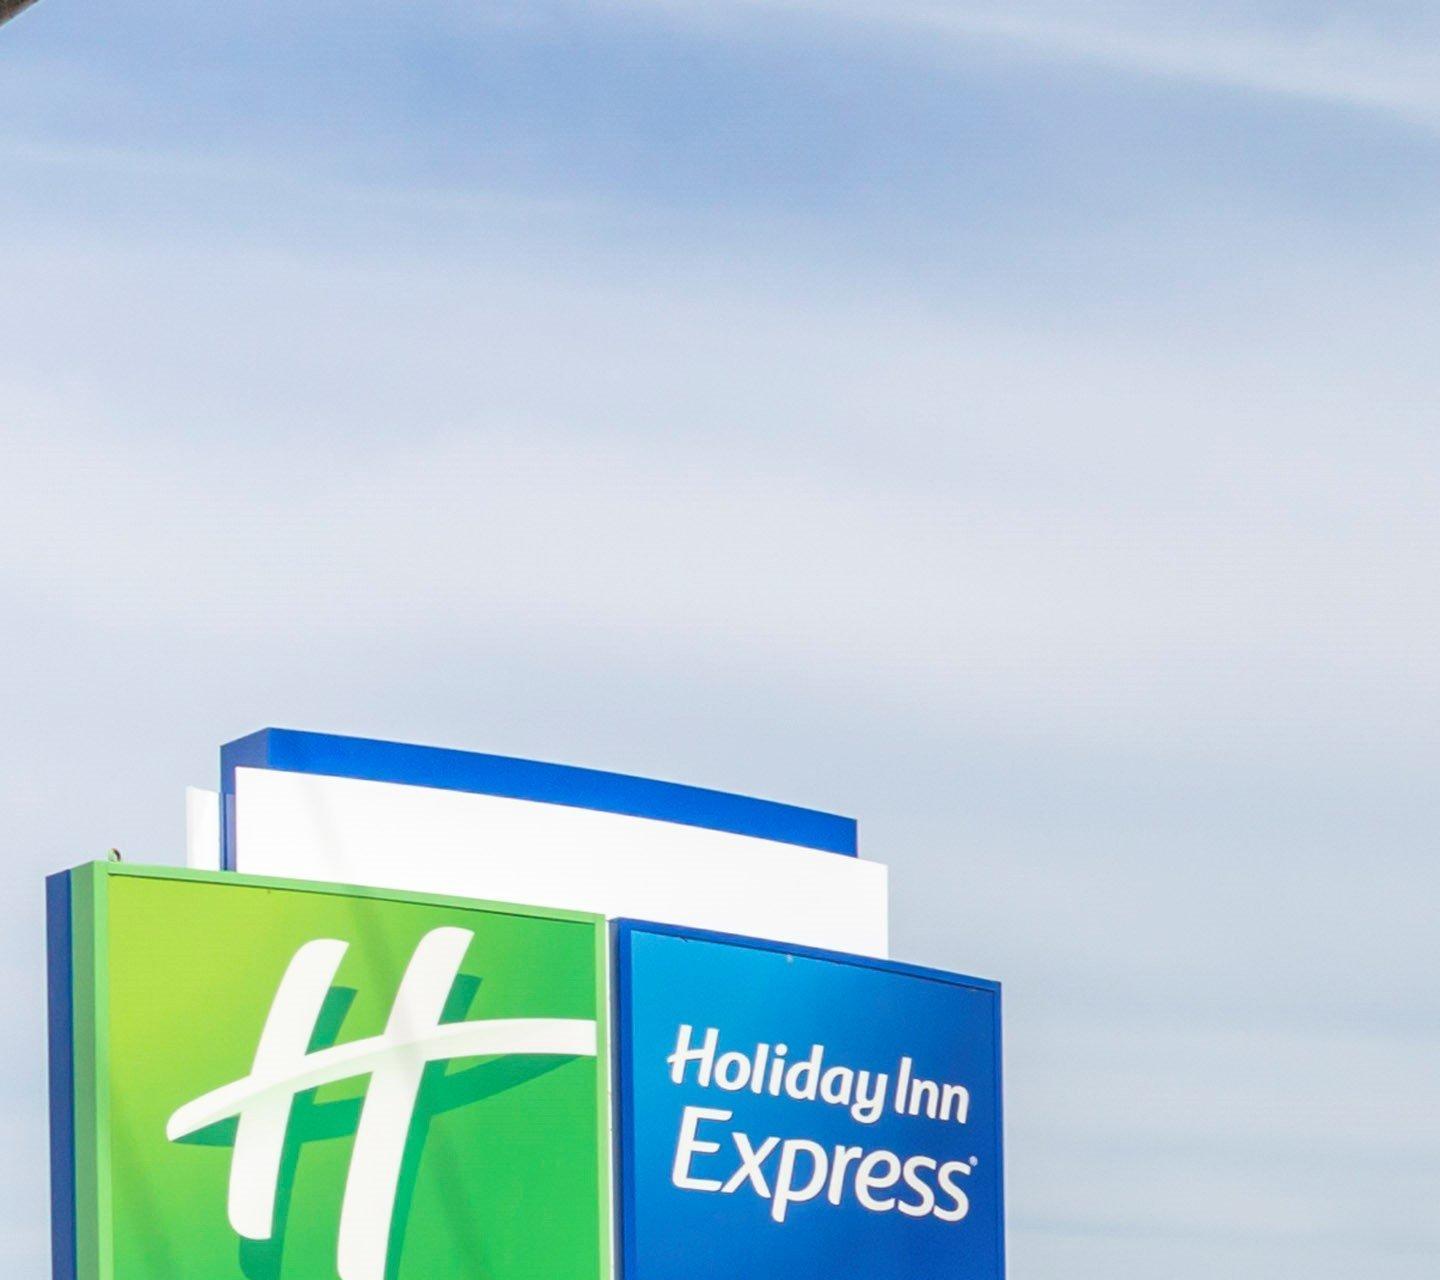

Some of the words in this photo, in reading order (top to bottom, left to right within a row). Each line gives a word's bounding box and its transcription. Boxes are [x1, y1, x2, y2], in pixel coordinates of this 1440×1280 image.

[666, 1023, 888, 1124] Holiday
[895, 1056, 970, 1124] Inn
[672, 1105, 978, 1223] Express
